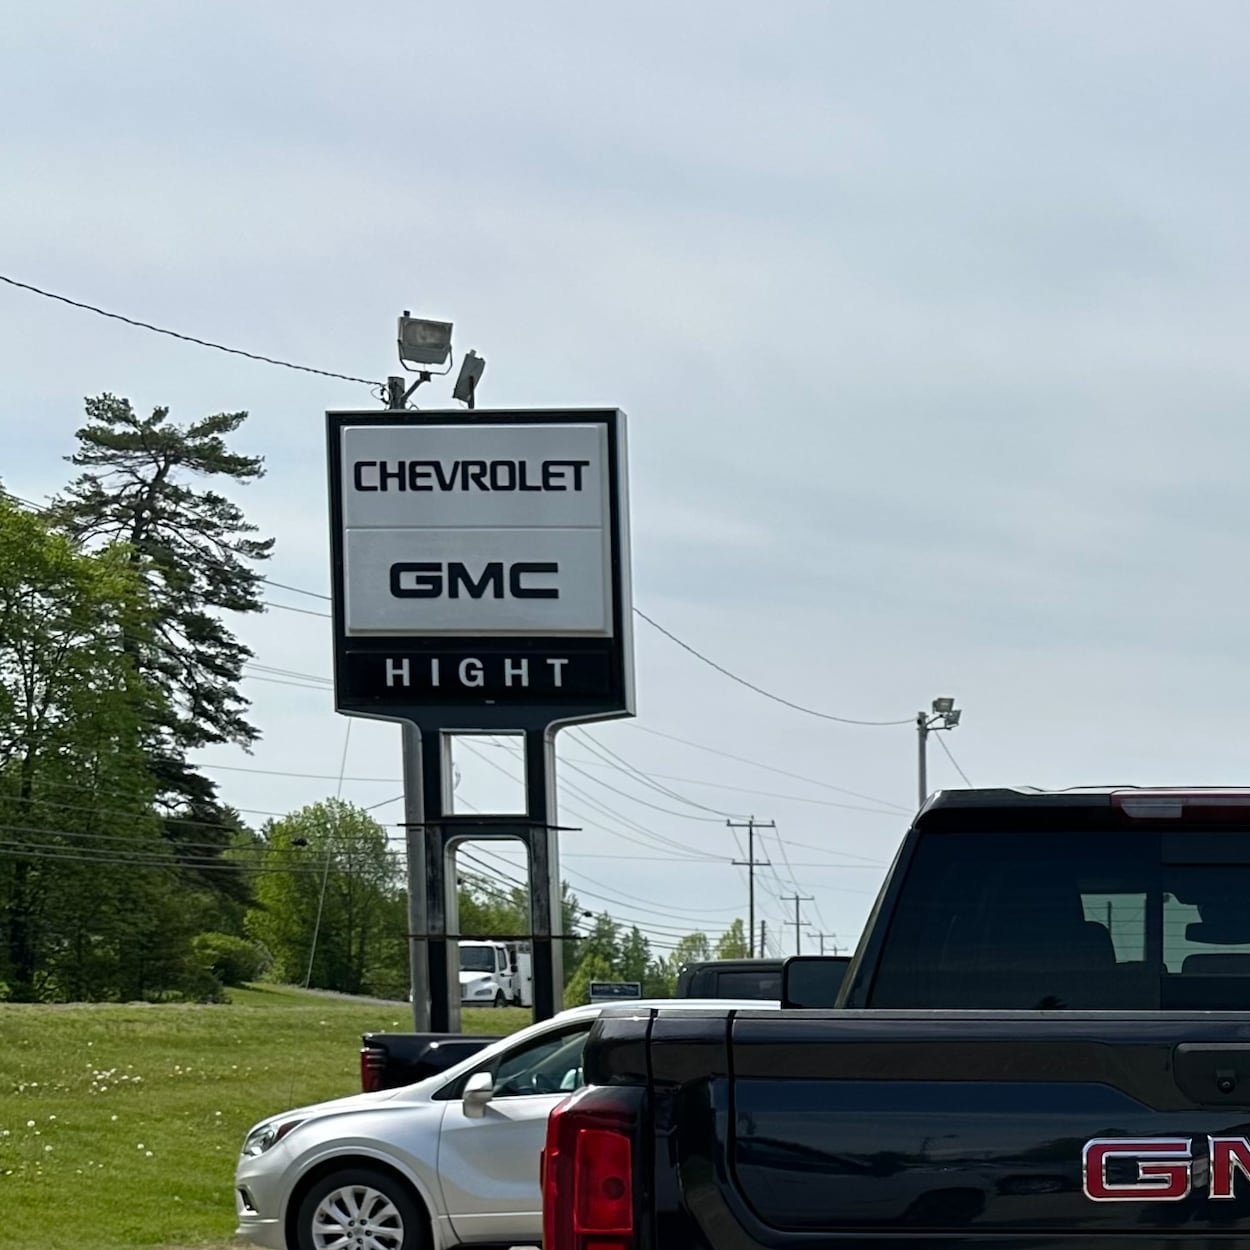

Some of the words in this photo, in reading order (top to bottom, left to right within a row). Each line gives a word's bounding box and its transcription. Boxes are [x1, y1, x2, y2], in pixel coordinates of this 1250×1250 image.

[353, 460, 590, 492] CHEVROLET
[389, 562, 559, 599] GMC
[385, 657, 569, 687] HIGHT
